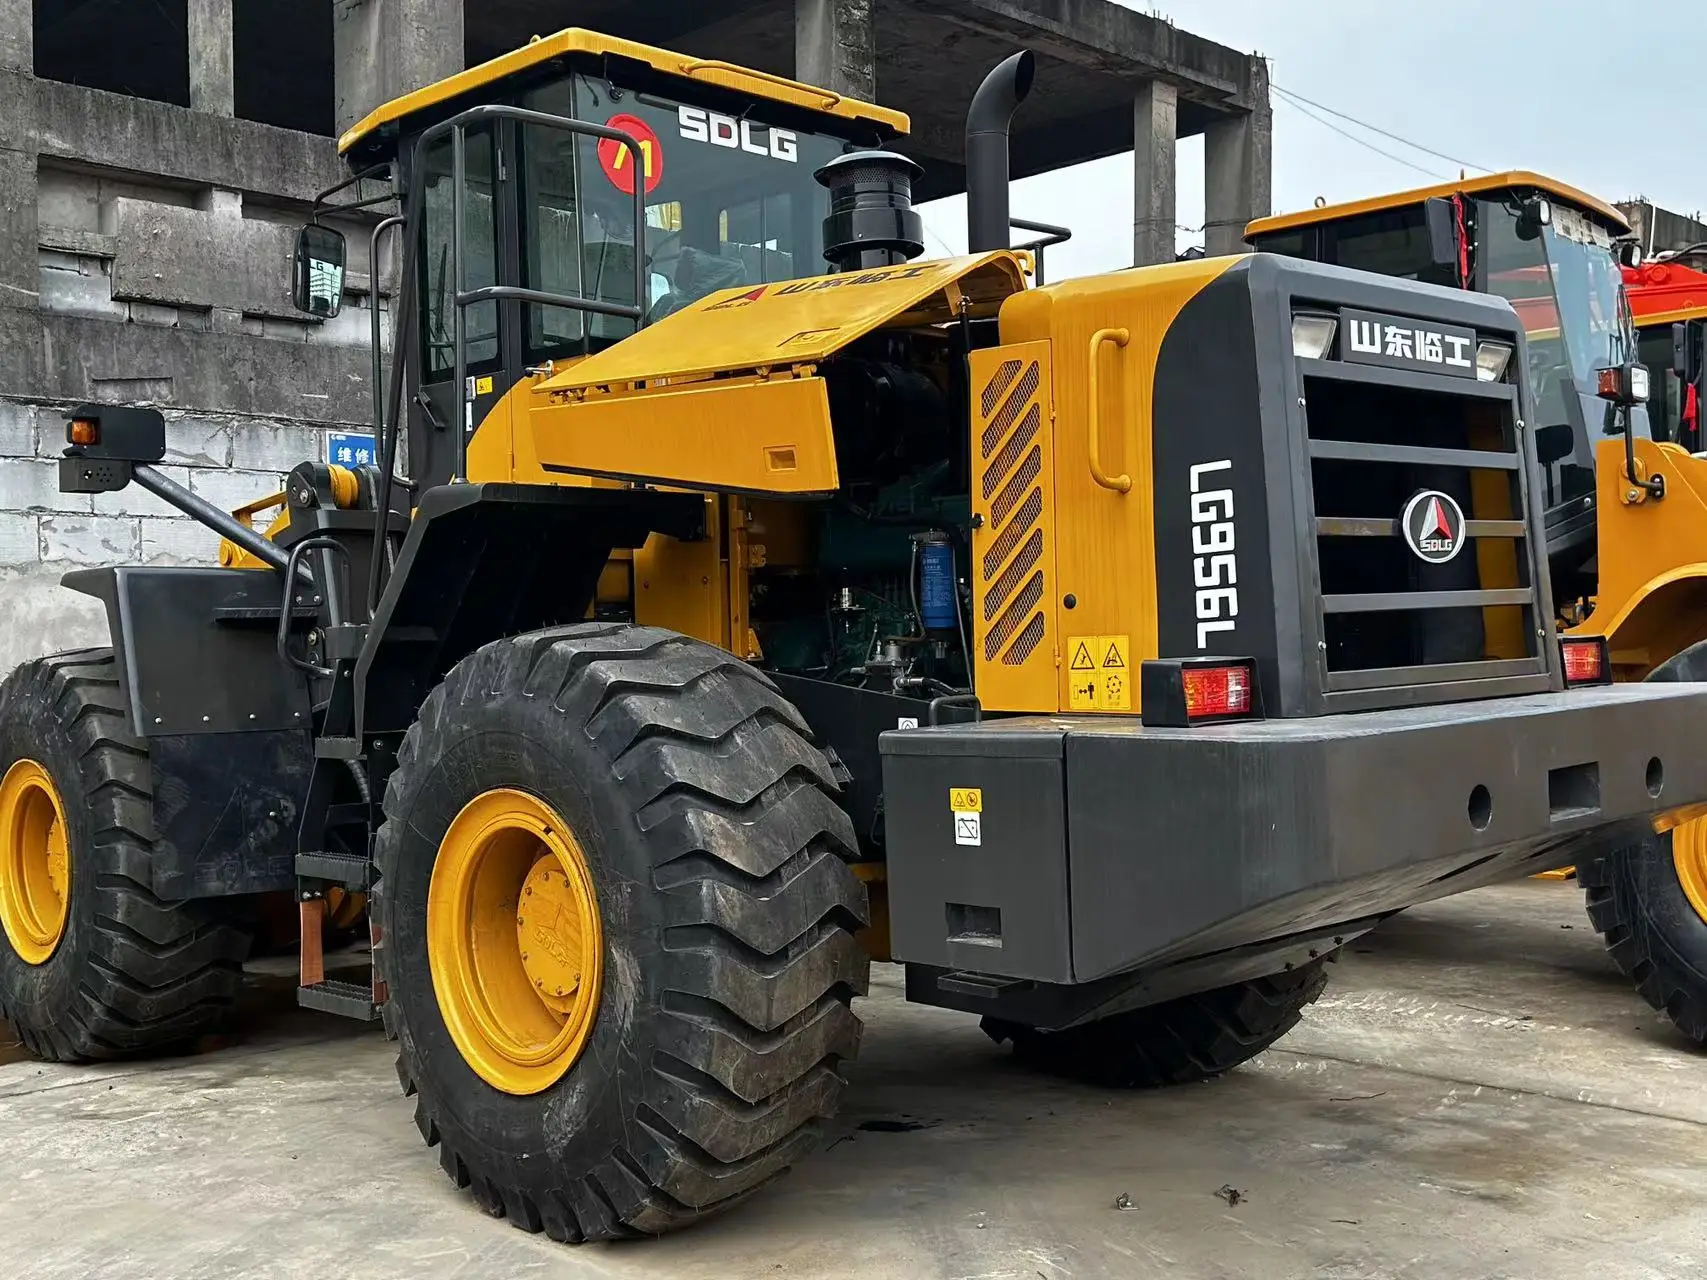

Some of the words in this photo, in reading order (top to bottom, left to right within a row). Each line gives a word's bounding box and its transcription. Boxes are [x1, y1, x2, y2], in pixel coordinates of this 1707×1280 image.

[678, 105, 798, 163] SDLG
[1350, 319, 1472, 368] 山东临工
[337, 447, 377, 464] 维修
[1190, 459, 1239, 649] LG956L
[1419, 539, 1453, 552] SDLG
